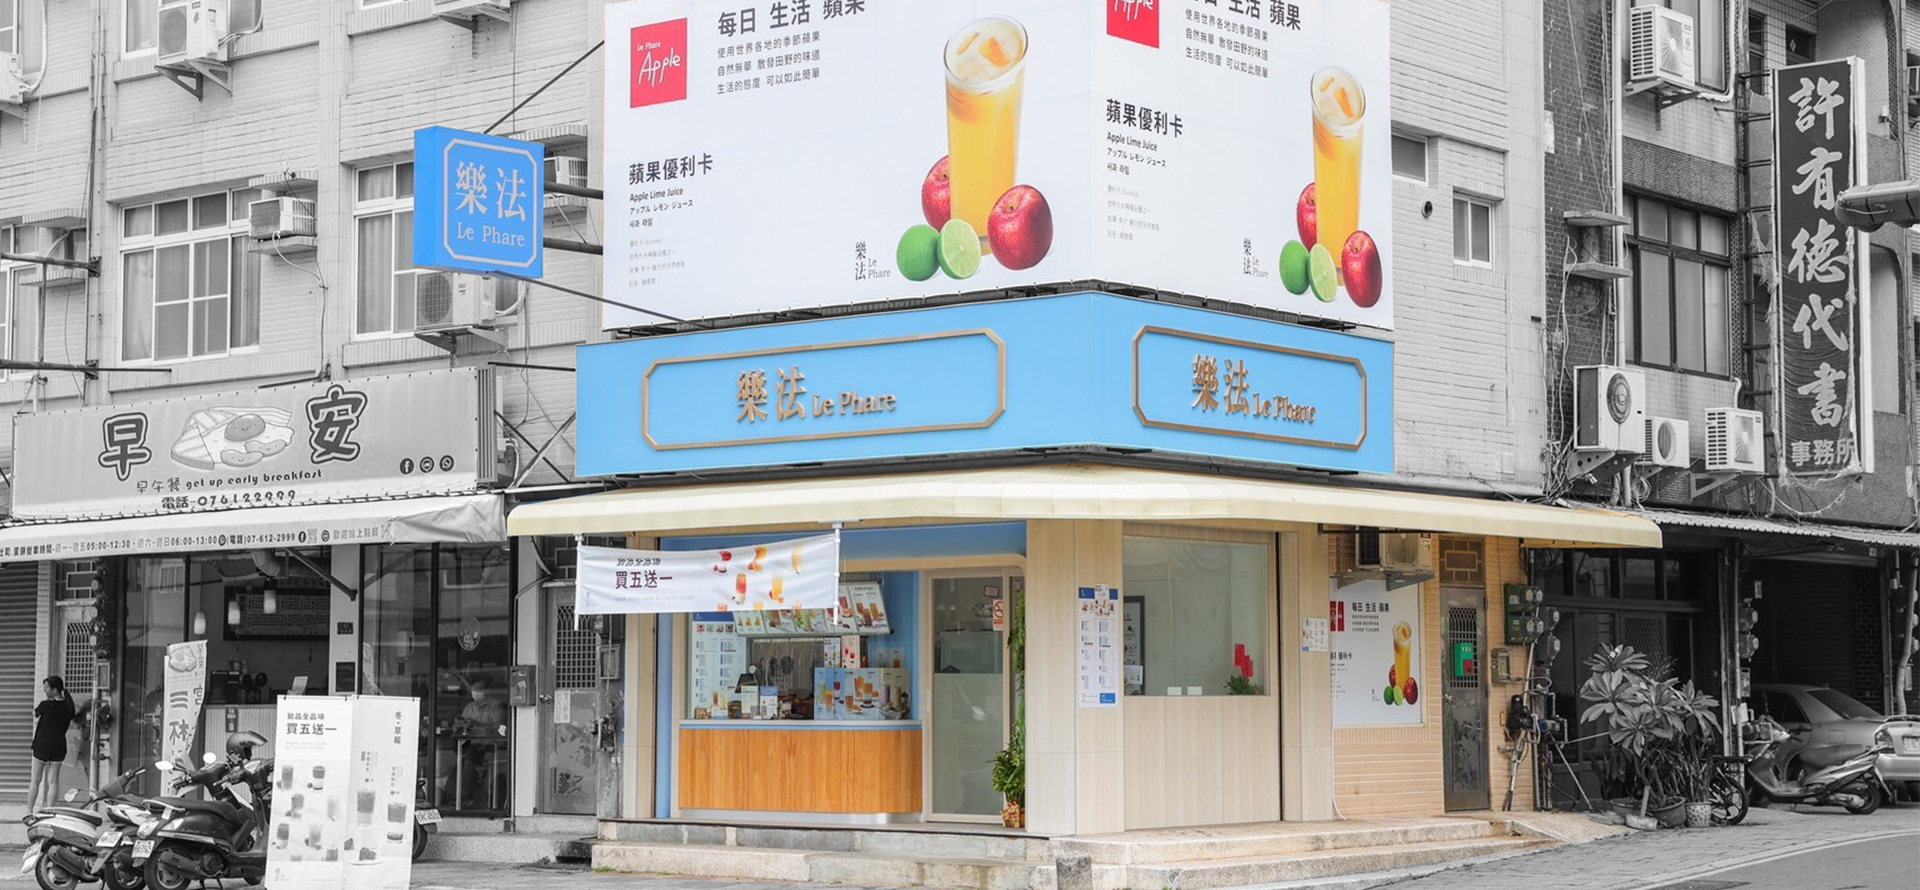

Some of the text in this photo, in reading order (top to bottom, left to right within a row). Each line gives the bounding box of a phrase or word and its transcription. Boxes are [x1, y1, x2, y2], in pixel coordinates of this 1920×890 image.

[718, 8, 756, 38] 每日
[770, 0, 811, 29] 生活
[1270, 0, 1302, 31] 蘋果
[717, 31, 821, 59] 使用世界各地的季節蘋果
[638, 46, 682, 88] Apple
[1106, 98, 1184, 138] 蘋果優利卡
[1107, 131, 1158, 152] Apple Lime Juice
[629, 153, 714, 185] 蘋果優利卡
[455, 160, 528, 222] 樂法
[629, 186, 684, 203] Apple Lime Juice
[457, 222, 526, 247] Le Phare
[854, 240, 867, 281] 樂法
[868, 269, 891, 279] Phare
[737, 366, 897, 424] 樂法 Le Phare
[1191, 353, 1317, 424] 樂法 Le Phare
[1790, 438, 1855, 467] 事務所
[136, 468, 324, 494] 早午餐 get up early breakfast
[615, 569, 673, 589] 買五送一
[286, 722, 337, 736] 買五送一
